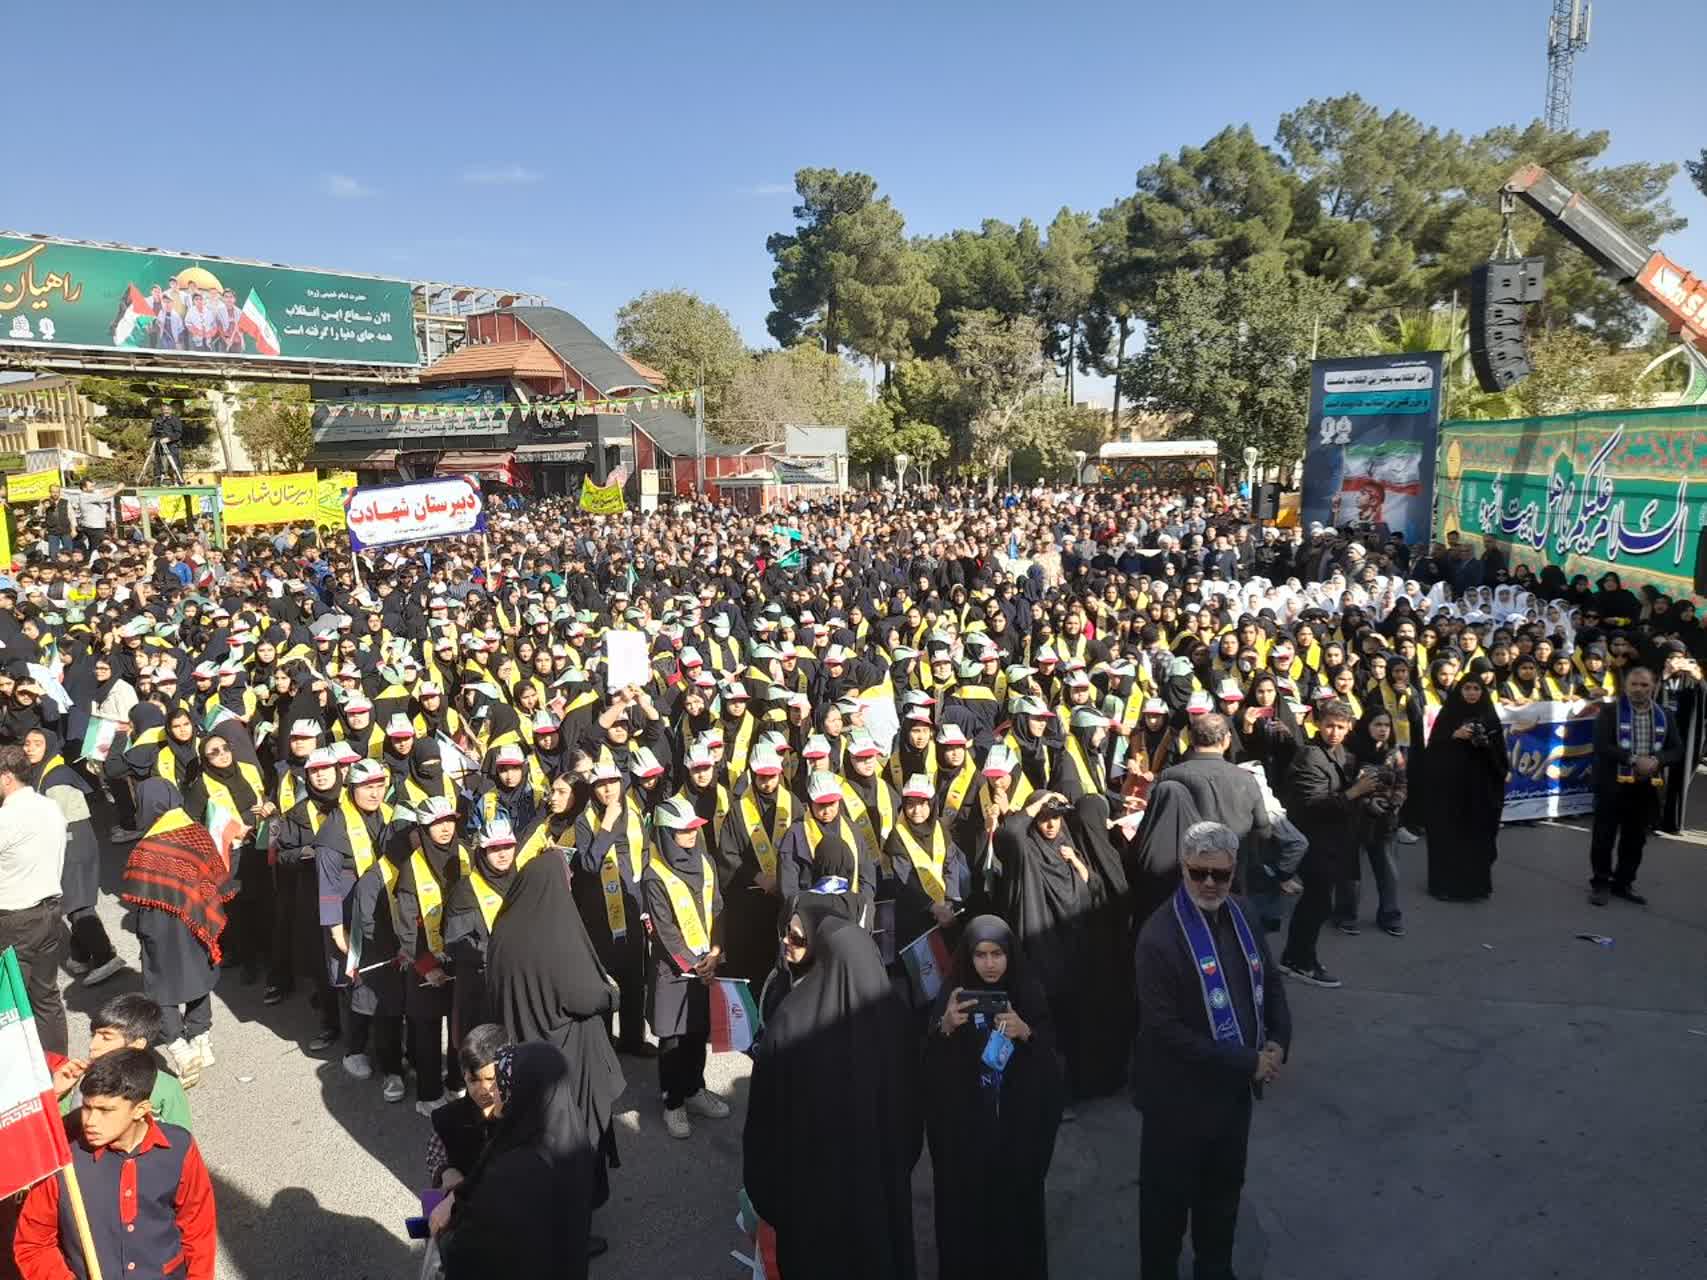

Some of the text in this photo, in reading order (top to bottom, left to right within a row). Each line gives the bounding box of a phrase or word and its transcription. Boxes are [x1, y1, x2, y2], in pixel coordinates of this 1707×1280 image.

[286, 304, 391, 325] الان شعاع این انقلاب
[283, 324, 392, 342] همه جای دنیا را گرفته است
[222, 481, 270, 506] شهادت
[267, 484, 314, 507] دبیرستان
[349, 497, 410, 524] شهادت
[414, 492, 476, 522] دبیرستان
